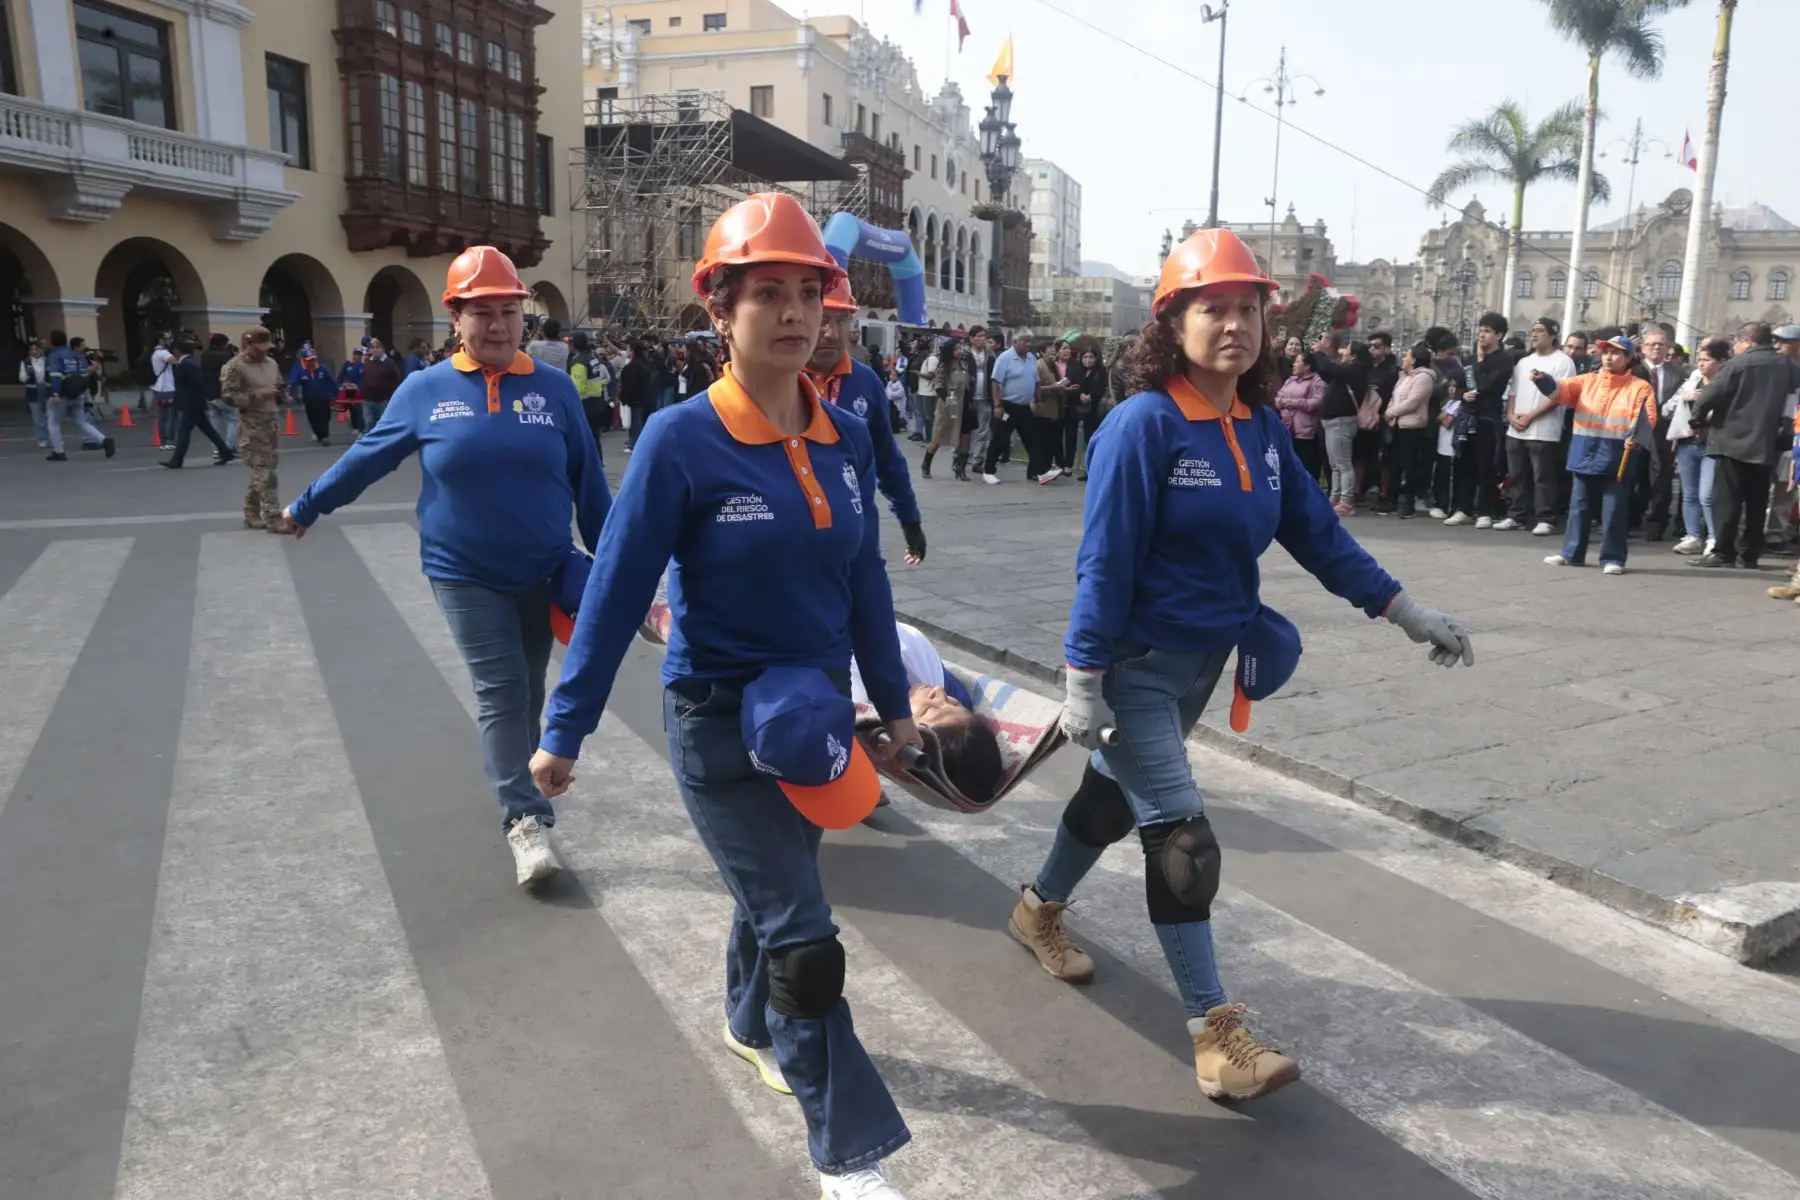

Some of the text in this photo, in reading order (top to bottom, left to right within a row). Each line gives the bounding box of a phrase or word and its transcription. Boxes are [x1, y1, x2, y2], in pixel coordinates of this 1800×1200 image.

[519, 414, 554, 426] LIMA
[1179, 458, 1210, 468] GESTIÓN
[1173, 468, 1189, 476] DEL
[1168, 476, 1222, 486] DE DESASTRES
[726, 493, 762, 504] GESTIÓN
[716, 512, 775, 522] DE DESASTRES
